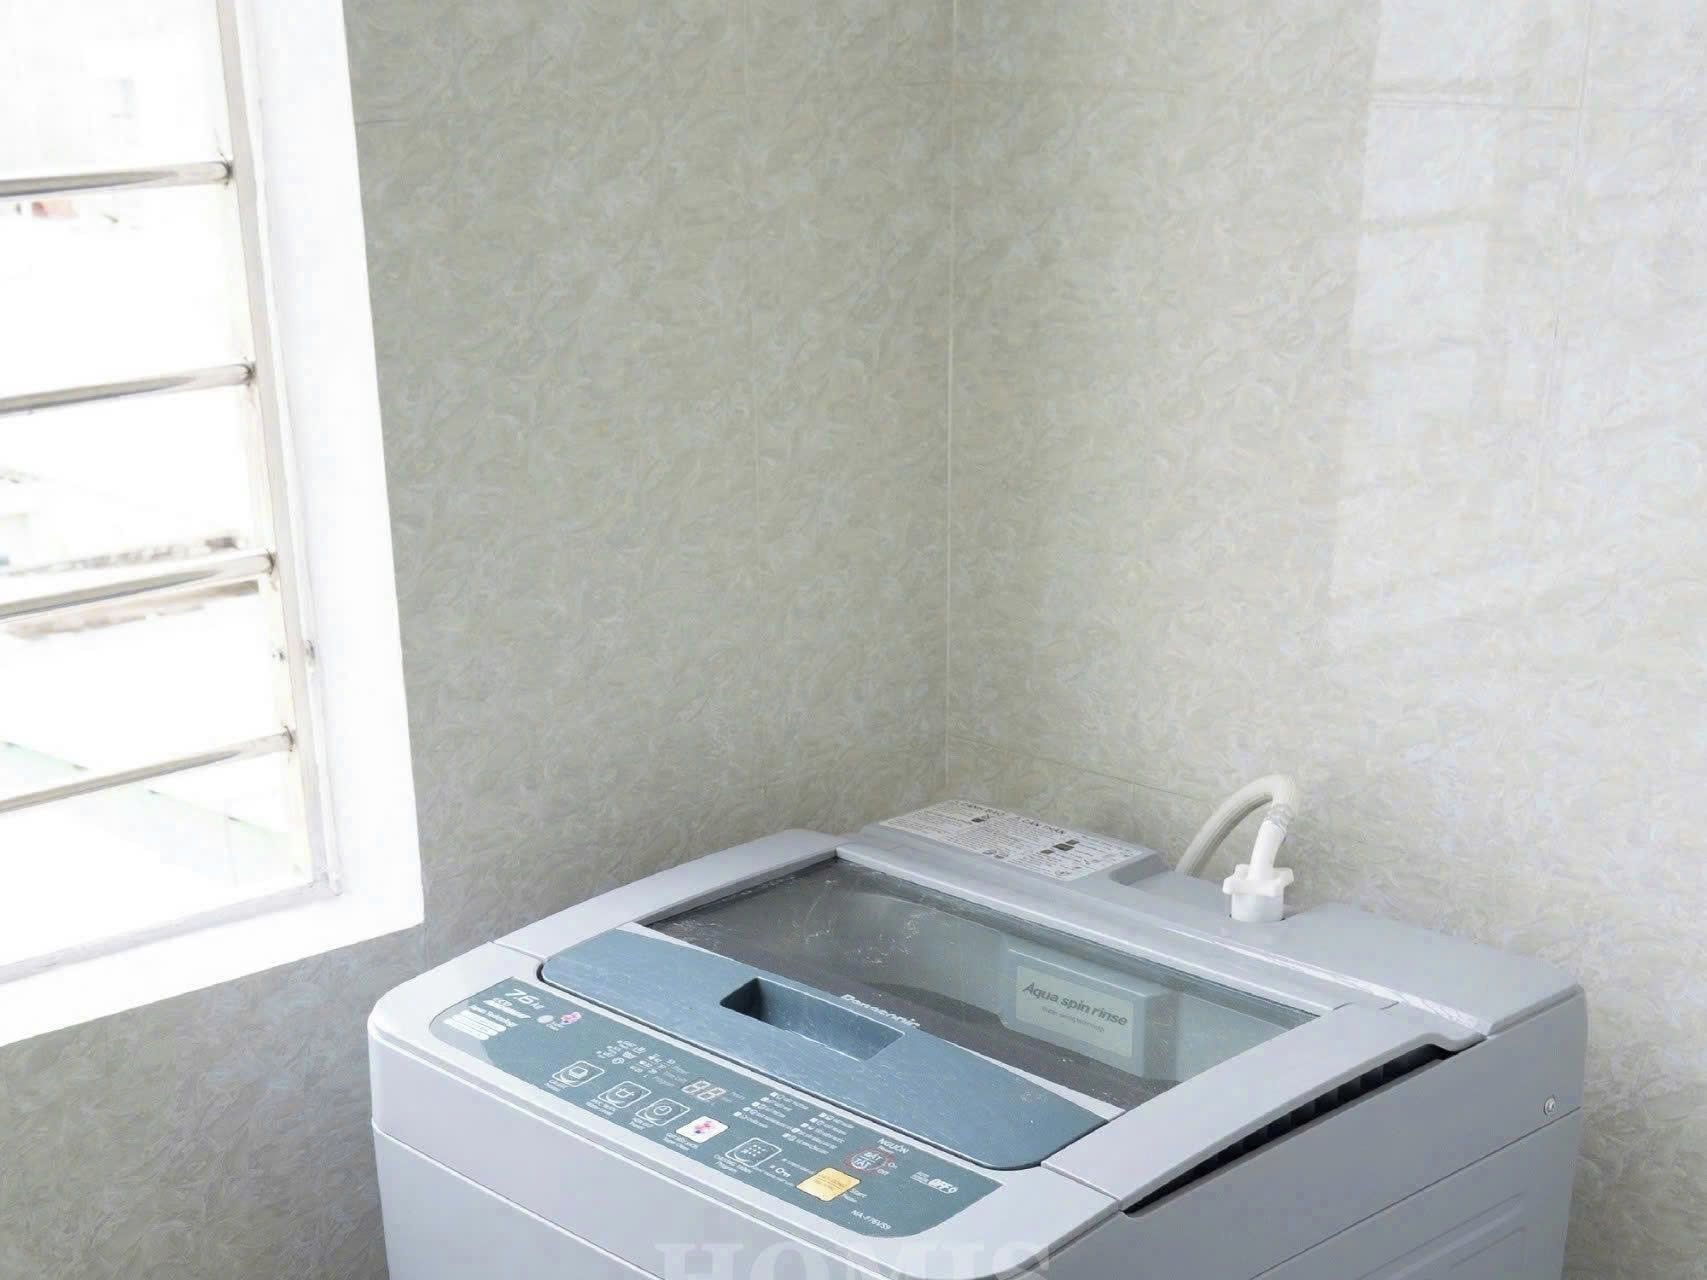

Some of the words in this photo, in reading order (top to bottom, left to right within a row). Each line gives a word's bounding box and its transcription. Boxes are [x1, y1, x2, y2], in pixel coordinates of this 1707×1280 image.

[1022, 982, 1059, 1002] Aqua
[1060, 997, 1091, 1015] spin
[1091, 1007, 1128, 1026] rinse
